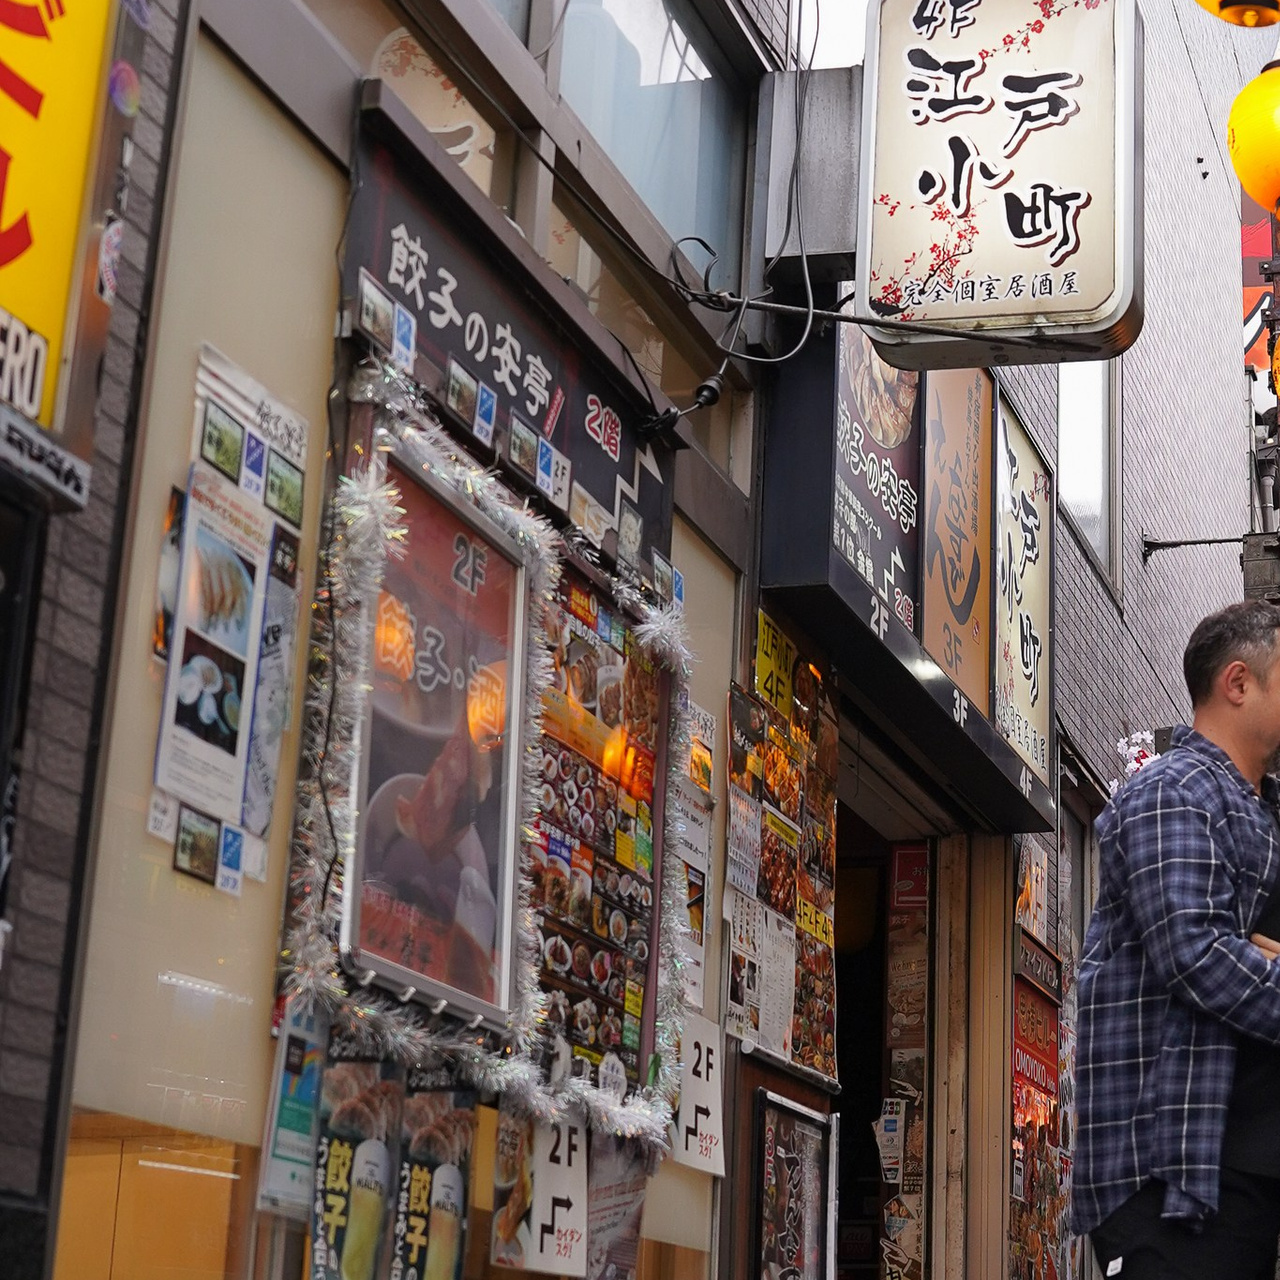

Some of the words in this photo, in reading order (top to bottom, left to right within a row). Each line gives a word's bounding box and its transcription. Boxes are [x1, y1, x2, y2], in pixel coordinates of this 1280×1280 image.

[902, 272, 1081, 307] 完全個室居酒屋
[388, 223, 553, 417] 餃子の安亭
[585, 393, 623, 463] 2階
[453, 532, 488, 596] 2F
[870, 596, 889, 642] 2F
[943, 623, 963, 676] 3F
[763, 671, 786, 709] 4F
[952, 688, 968, 727] 3F
[1020, 765, 1033, 800] 4F
[691, 1040, 714, 1082] 2F
[1015, 1048, 1047, 1087] OMOYOKO
[549, 1122, 579, 1168] 2F
[698, 1145, 712, 1160] スグ!
[699, 1130, 719, 1148] カイダン
[555, 1226, 582, 1244] カイダン
[555, 1242, 573, 1259] スグ!
